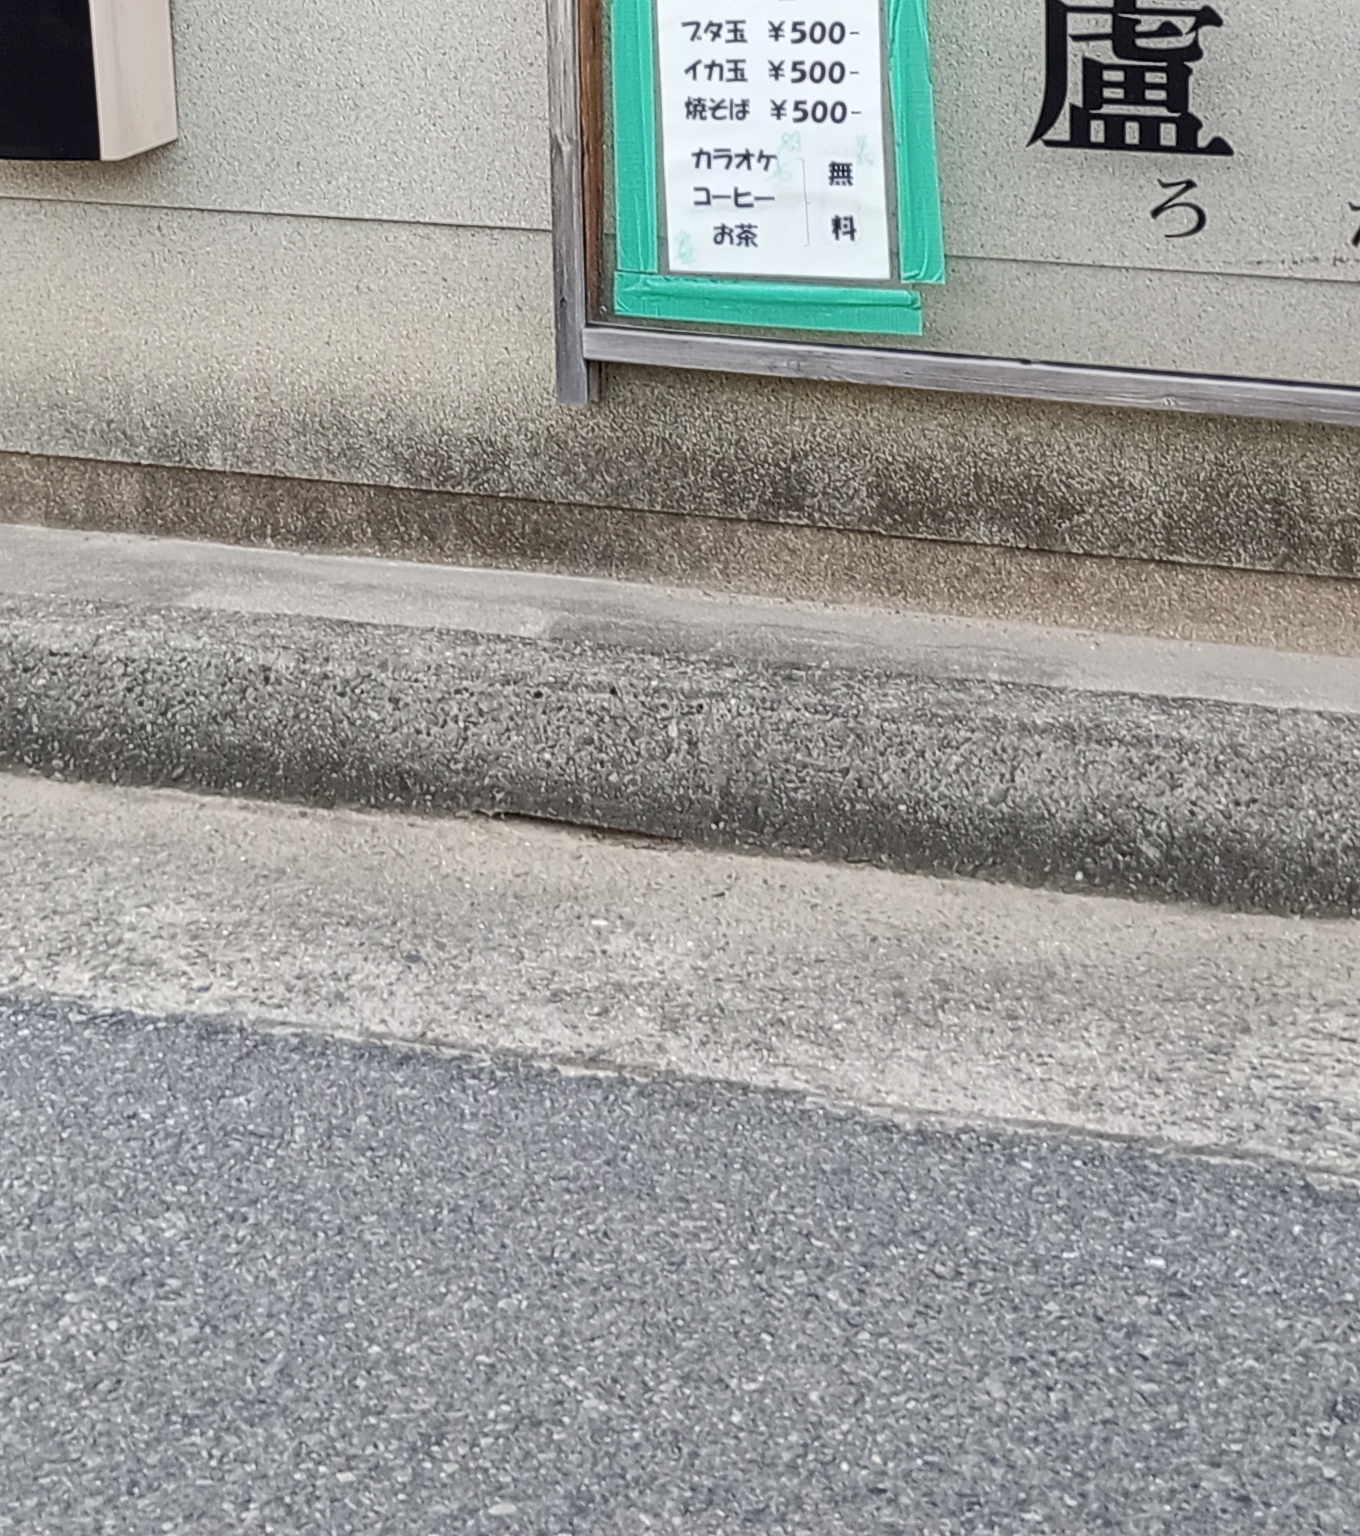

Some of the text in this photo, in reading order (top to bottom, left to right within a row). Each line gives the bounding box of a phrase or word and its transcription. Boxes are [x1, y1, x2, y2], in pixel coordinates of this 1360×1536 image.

[684, 59, 748, 83] イカ玉
[684, 96, 750, 122] 焼そば
[691, 148, 778, 172] カラオケ
[693, 186, 775, 209] コーヒー
[712, 223, 759, 248] お茶
